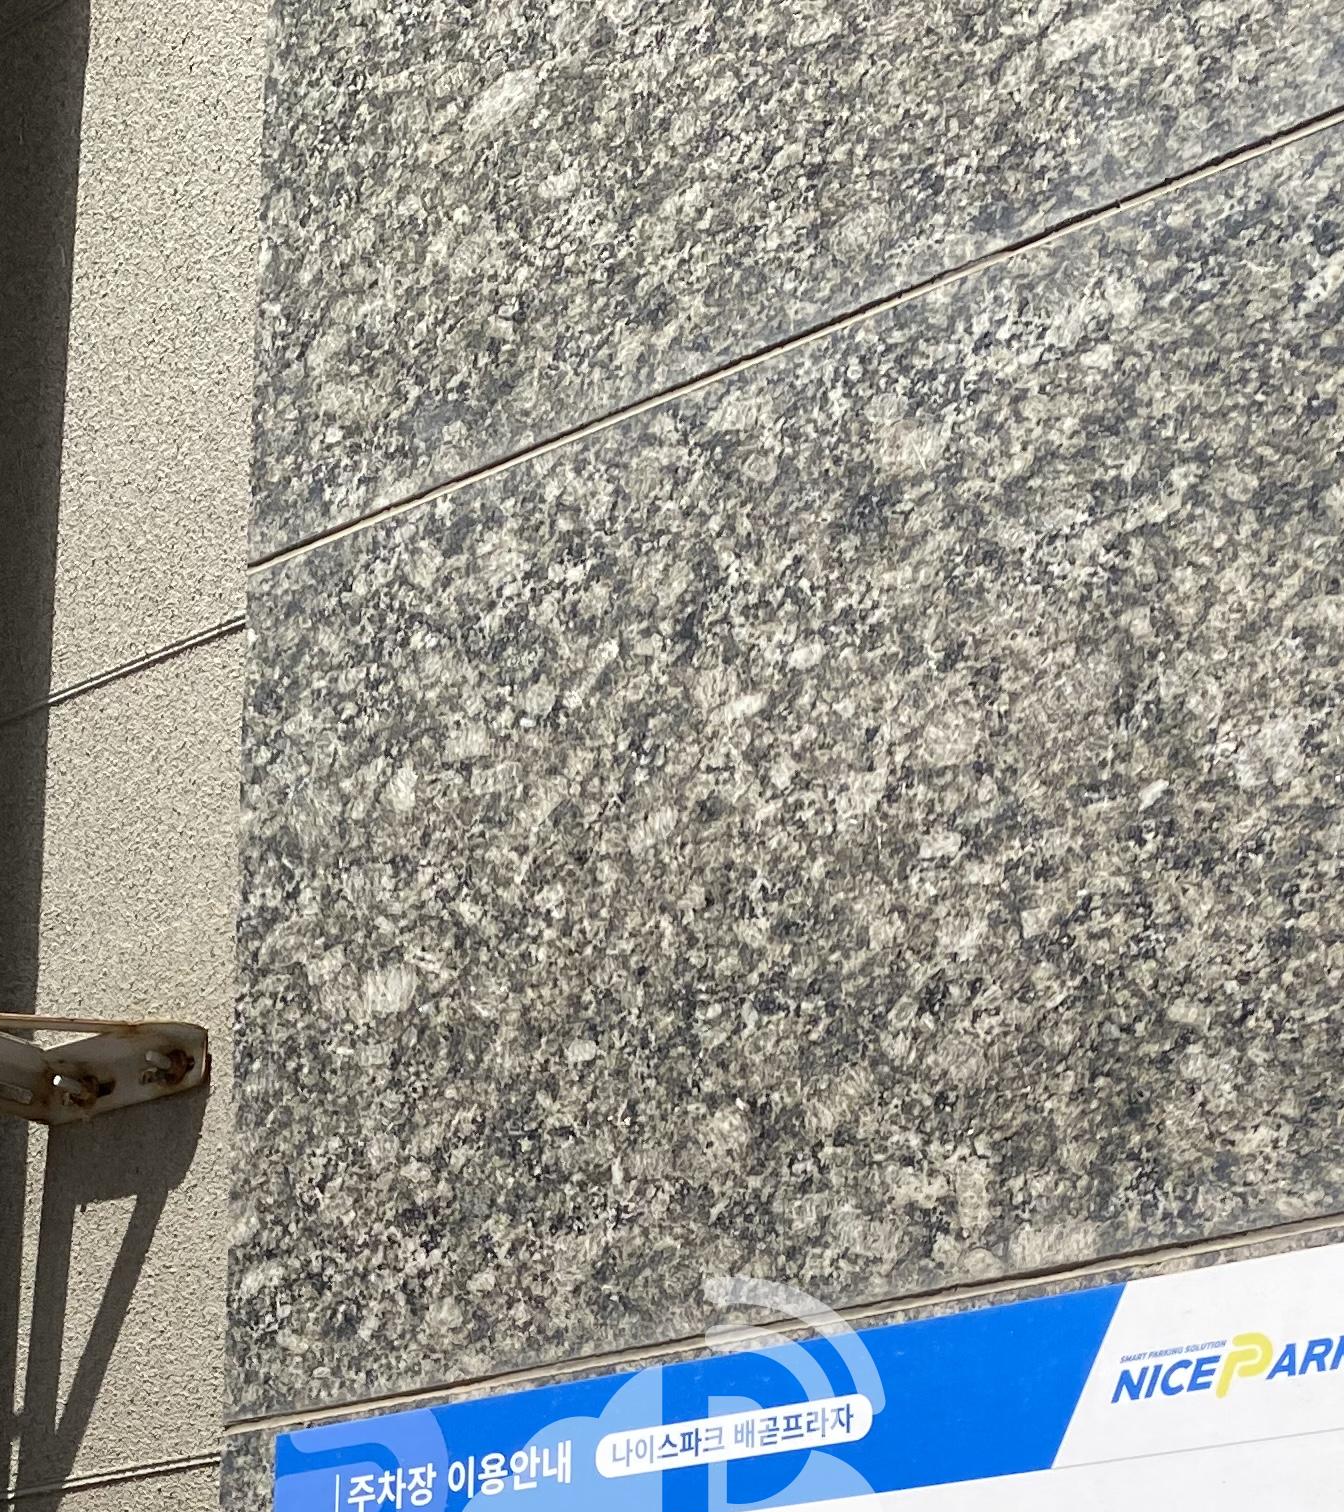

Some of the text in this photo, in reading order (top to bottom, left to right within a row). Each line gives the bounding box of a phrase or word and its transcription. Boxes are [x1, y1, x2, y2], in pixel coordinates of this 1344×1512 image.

[1119, 1351, 1148, 1363] SMART
[1185, 1339, 1228, 1354] SOLUTION
[447, 1440, 573, 1500] 이용안내
[611, 1424, 725, 1468] 나이스파크
[734, 1402, 855, 1449] 배곧프라자
